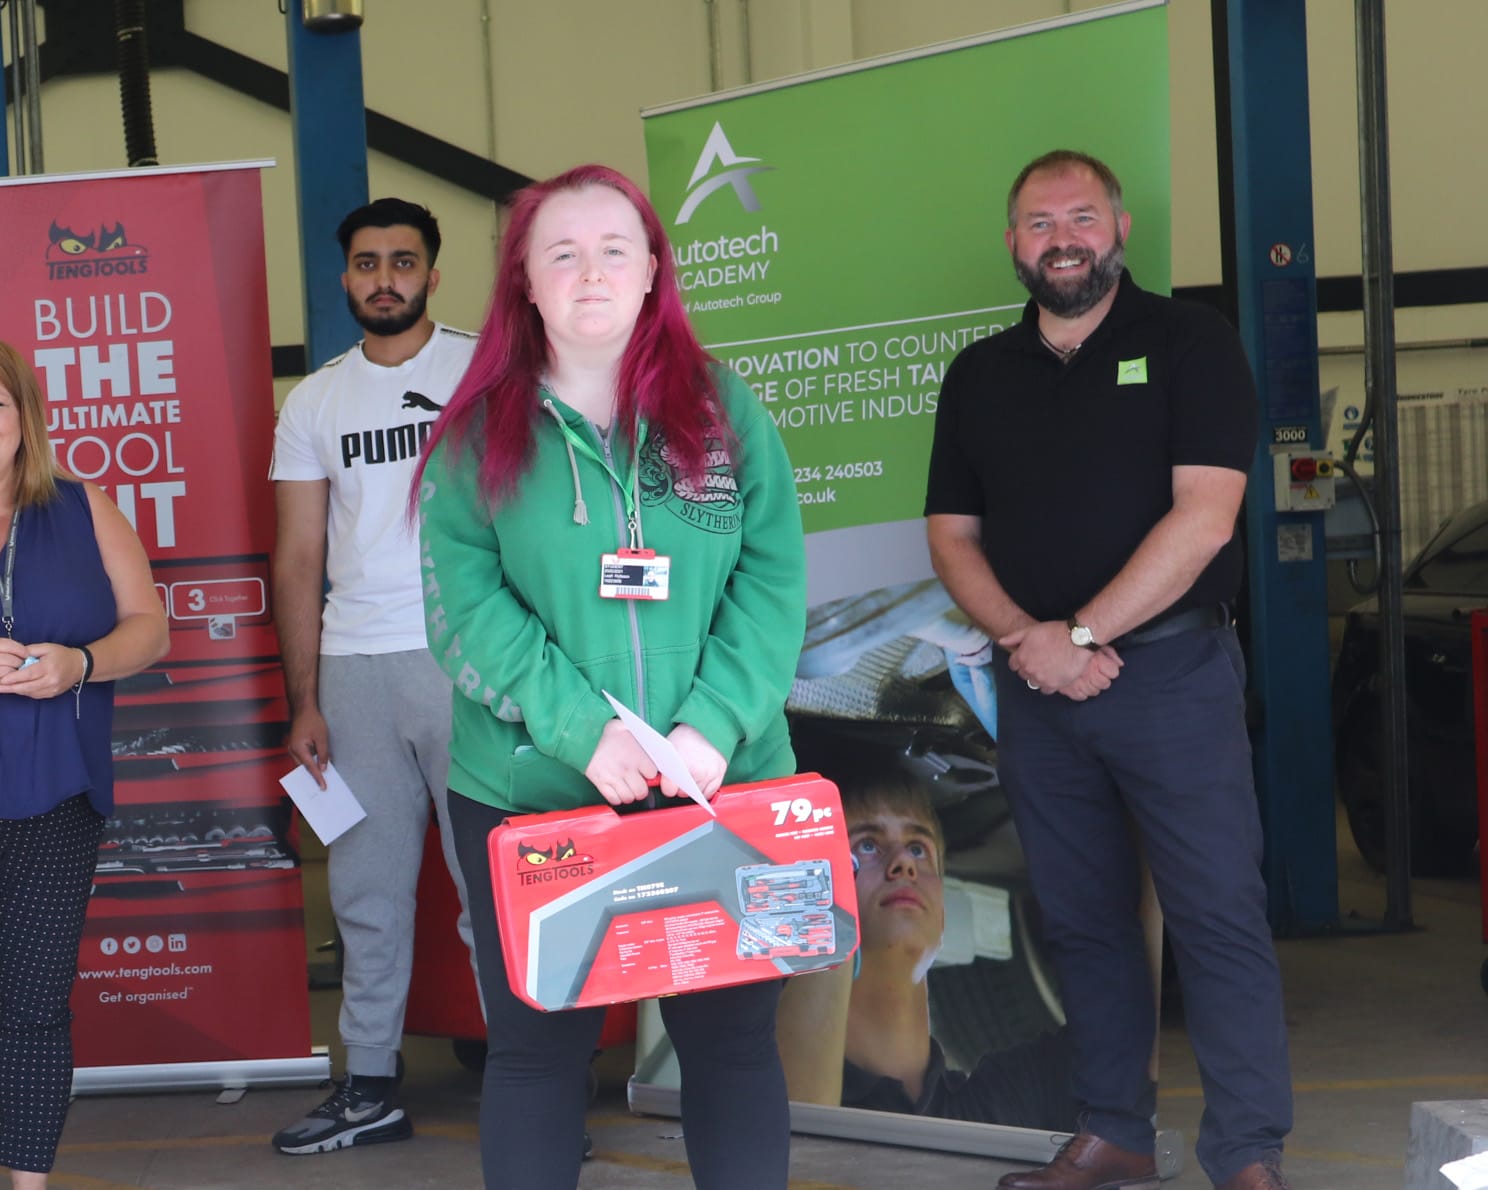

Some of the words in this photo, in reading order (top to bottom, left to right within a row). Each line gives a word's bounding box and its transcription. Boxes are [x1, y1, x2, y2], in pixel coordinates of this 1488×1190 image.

[693, 295, 744, 313] Autotech
[746, 292, 782, 305] Group
[34, 291, 172, 341] BUILD
[845, 340, 878, 364] TO
[34, 340, 177, 401] THE
[785, 376, 817, 399] OF
[824, 367, 900, 396] FRESH
[1275, 430, 1306, 441] 3000
[825, 460, 883, 481] 240503
[102, 480, 187, 549] IT
[187, 588, 206, 611] 3
[78, 962, 213, 981] www.tengtools.com
[98, 991, 122, 1004] Get
[125, 985, 188, 1005] organised
